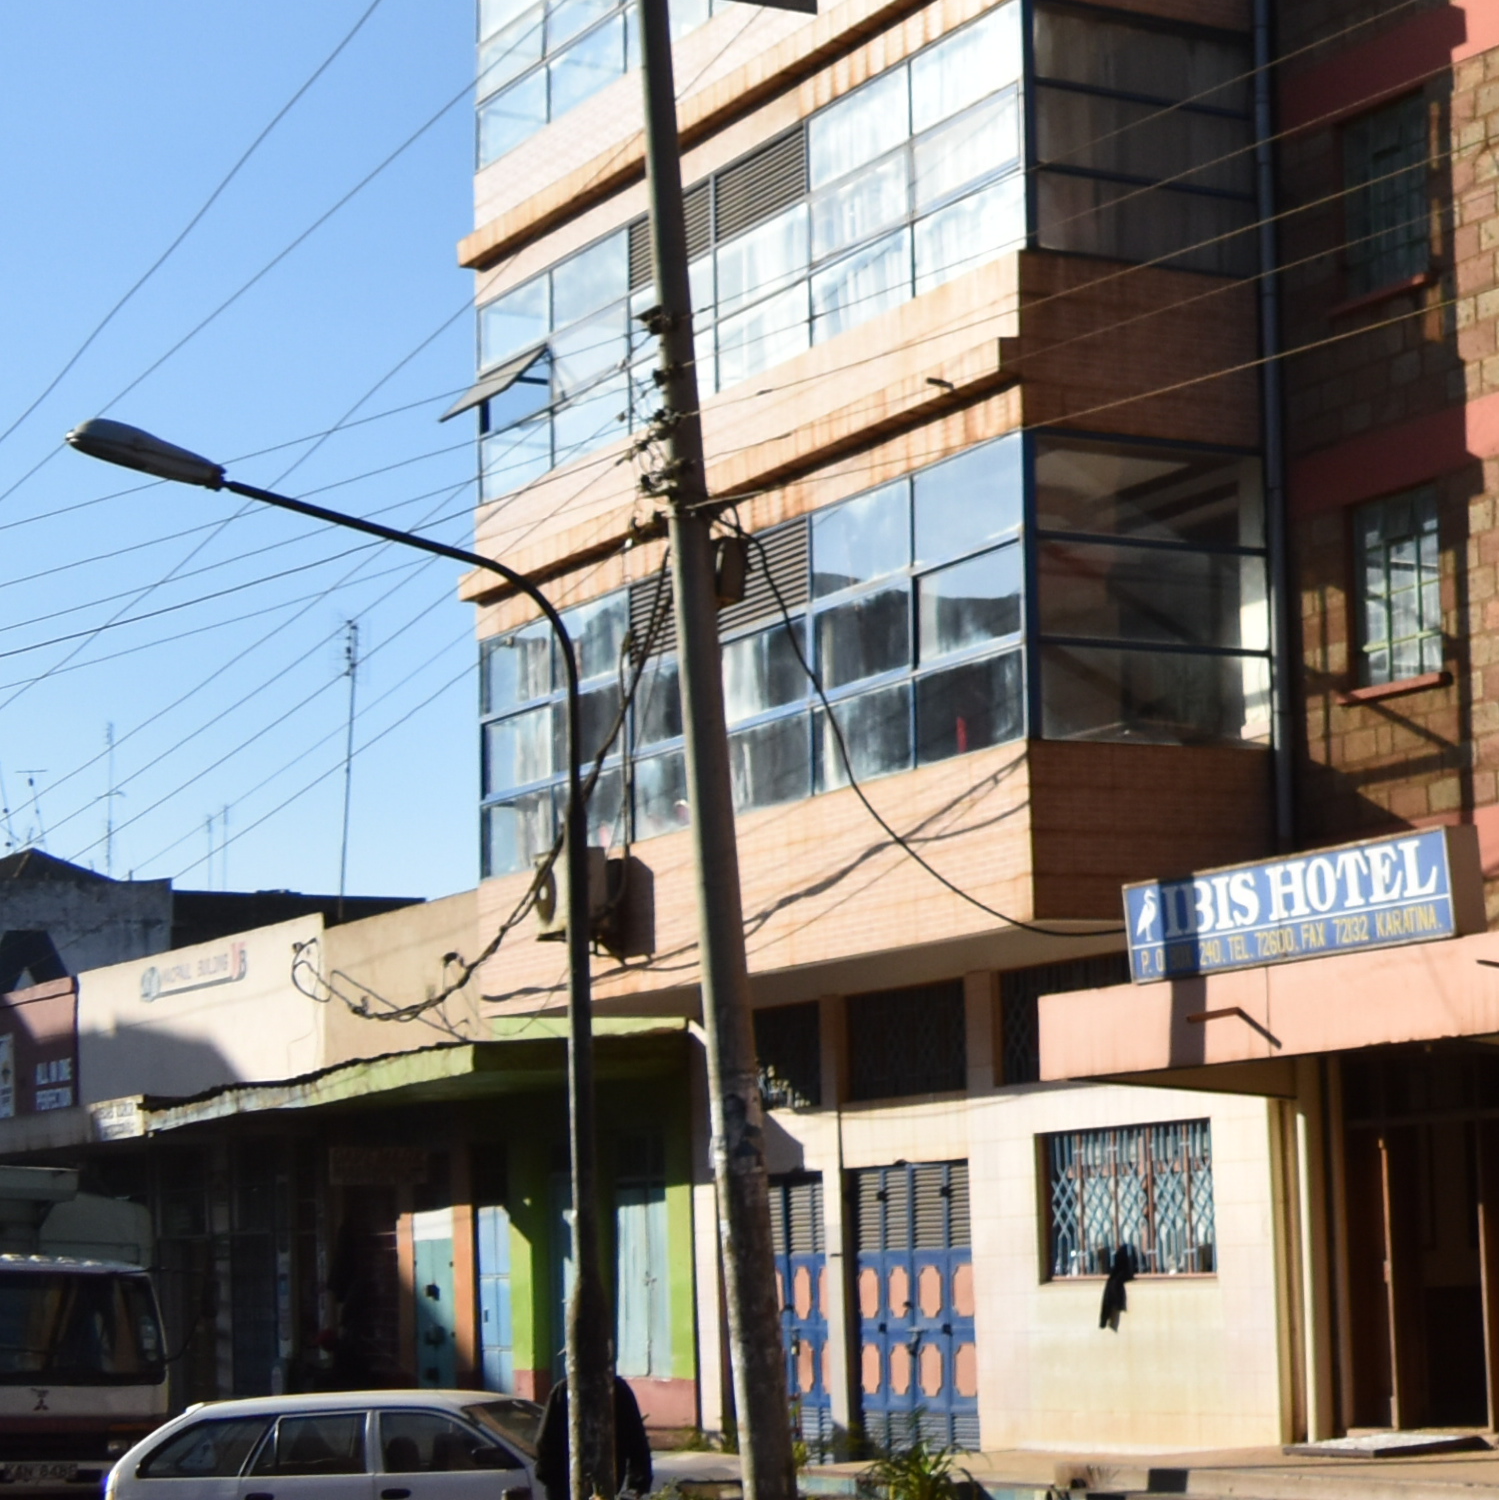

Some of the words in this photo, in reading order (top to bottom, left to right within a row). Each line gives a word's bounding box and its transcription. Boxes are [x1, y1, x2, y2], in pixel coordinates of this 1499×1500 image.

[1162, 872, 1260, 937] IBIS
[1265, 840, 1438, 920] HOTEL
[1301, 922, 1326, 950] FAX
